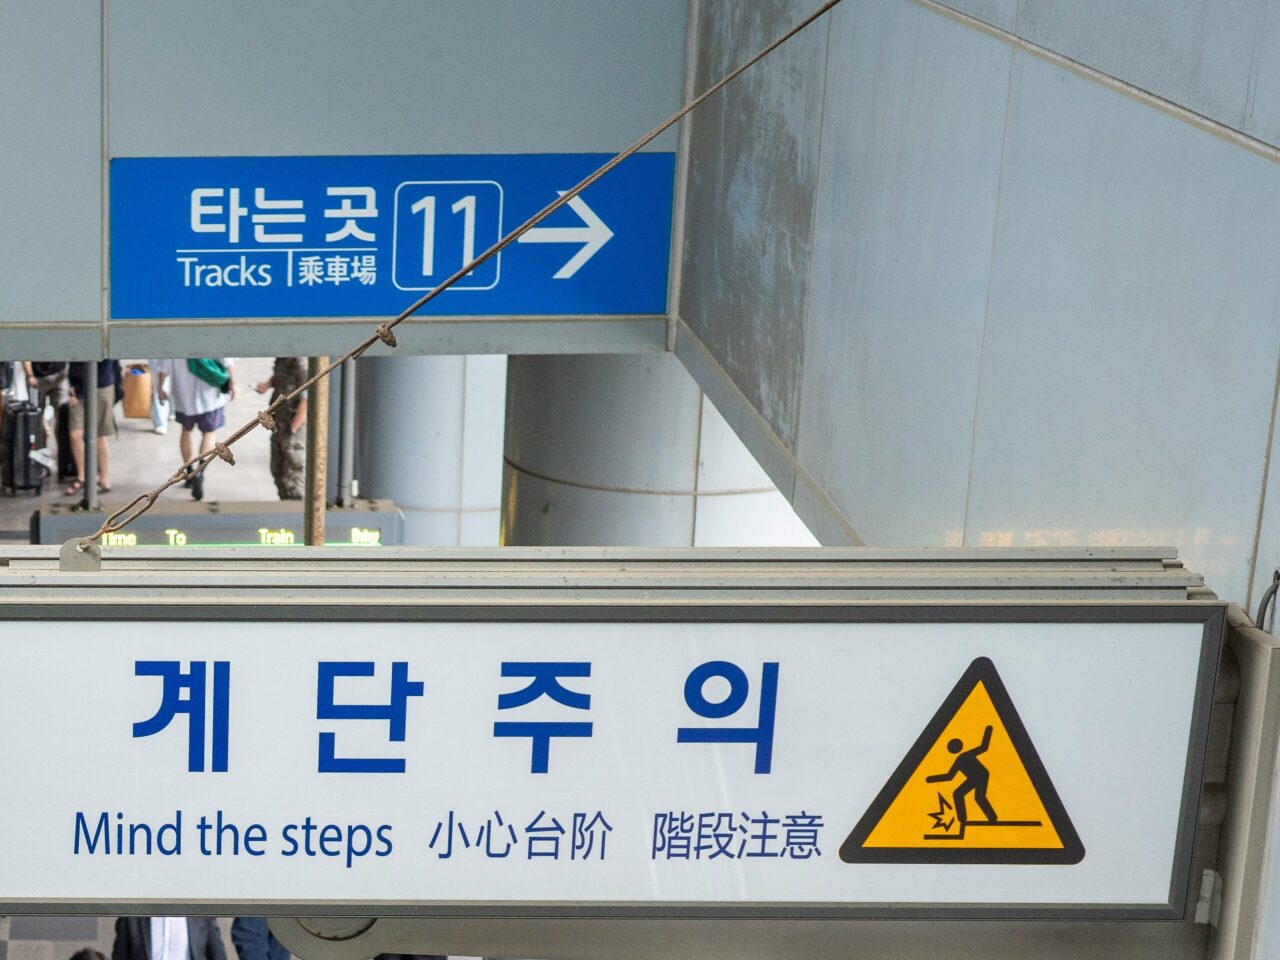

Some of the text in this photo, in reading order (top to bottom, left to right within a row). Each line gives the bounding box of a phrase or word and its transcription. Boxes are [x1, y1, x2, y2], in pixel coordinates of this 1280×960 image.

[190, 186, 379, 243] 타는 곳
[410, 195, 477, 277] 11
[177, 256, 272, 287] Tracks
[165, 529, 187, 545] To
[258, 528, 294, 544] Train
[73, 811, 394, 868] Mind the steps
[428, 811, 613, 861] 小心台阶
[652, 810, 825, 861] 階段注意
